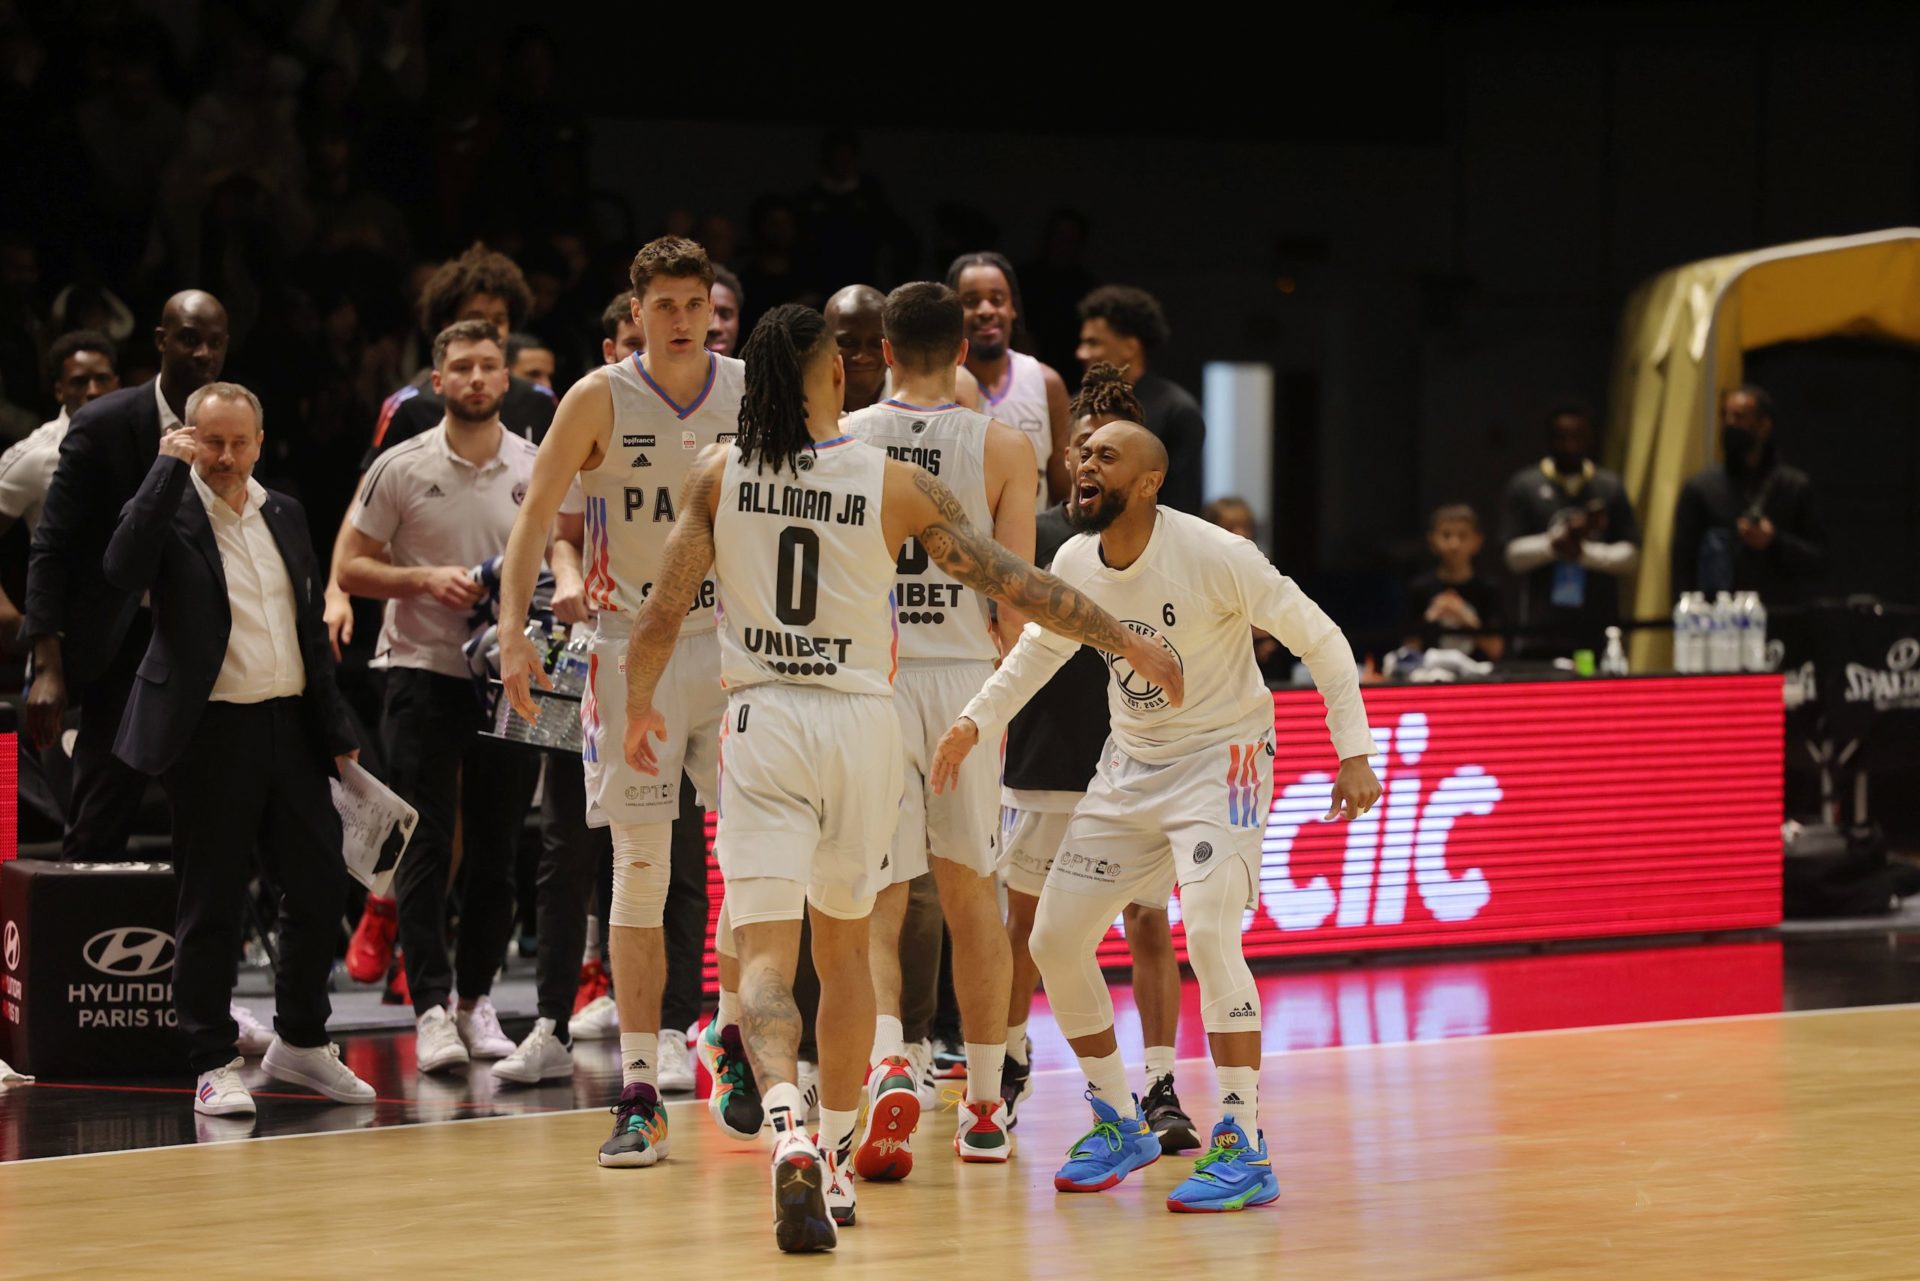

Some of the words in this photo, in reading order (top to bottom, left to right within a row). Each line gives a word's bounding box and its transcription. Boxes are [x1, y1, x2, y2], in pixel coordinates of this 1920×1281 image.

[623, 486, 676, 522] PA
[738, 481, 832, 522] ALLMAN
[836, 494, 867, 526] JR
[776, 525, 820, 626] 0
[897, 583, 963, 607] IBET
[1162, 602, 1176, 627] 6
[744, 627, 852, 664] UNIBET
[737, 703, 750, 733] 0
[1240, 712, 1503, 932] clic
[79, 1008, 149, 1028] PARIS
[1229, 1010, 1256, 1018] adidas
[1214, 1133, 1239, 1147] UNO
